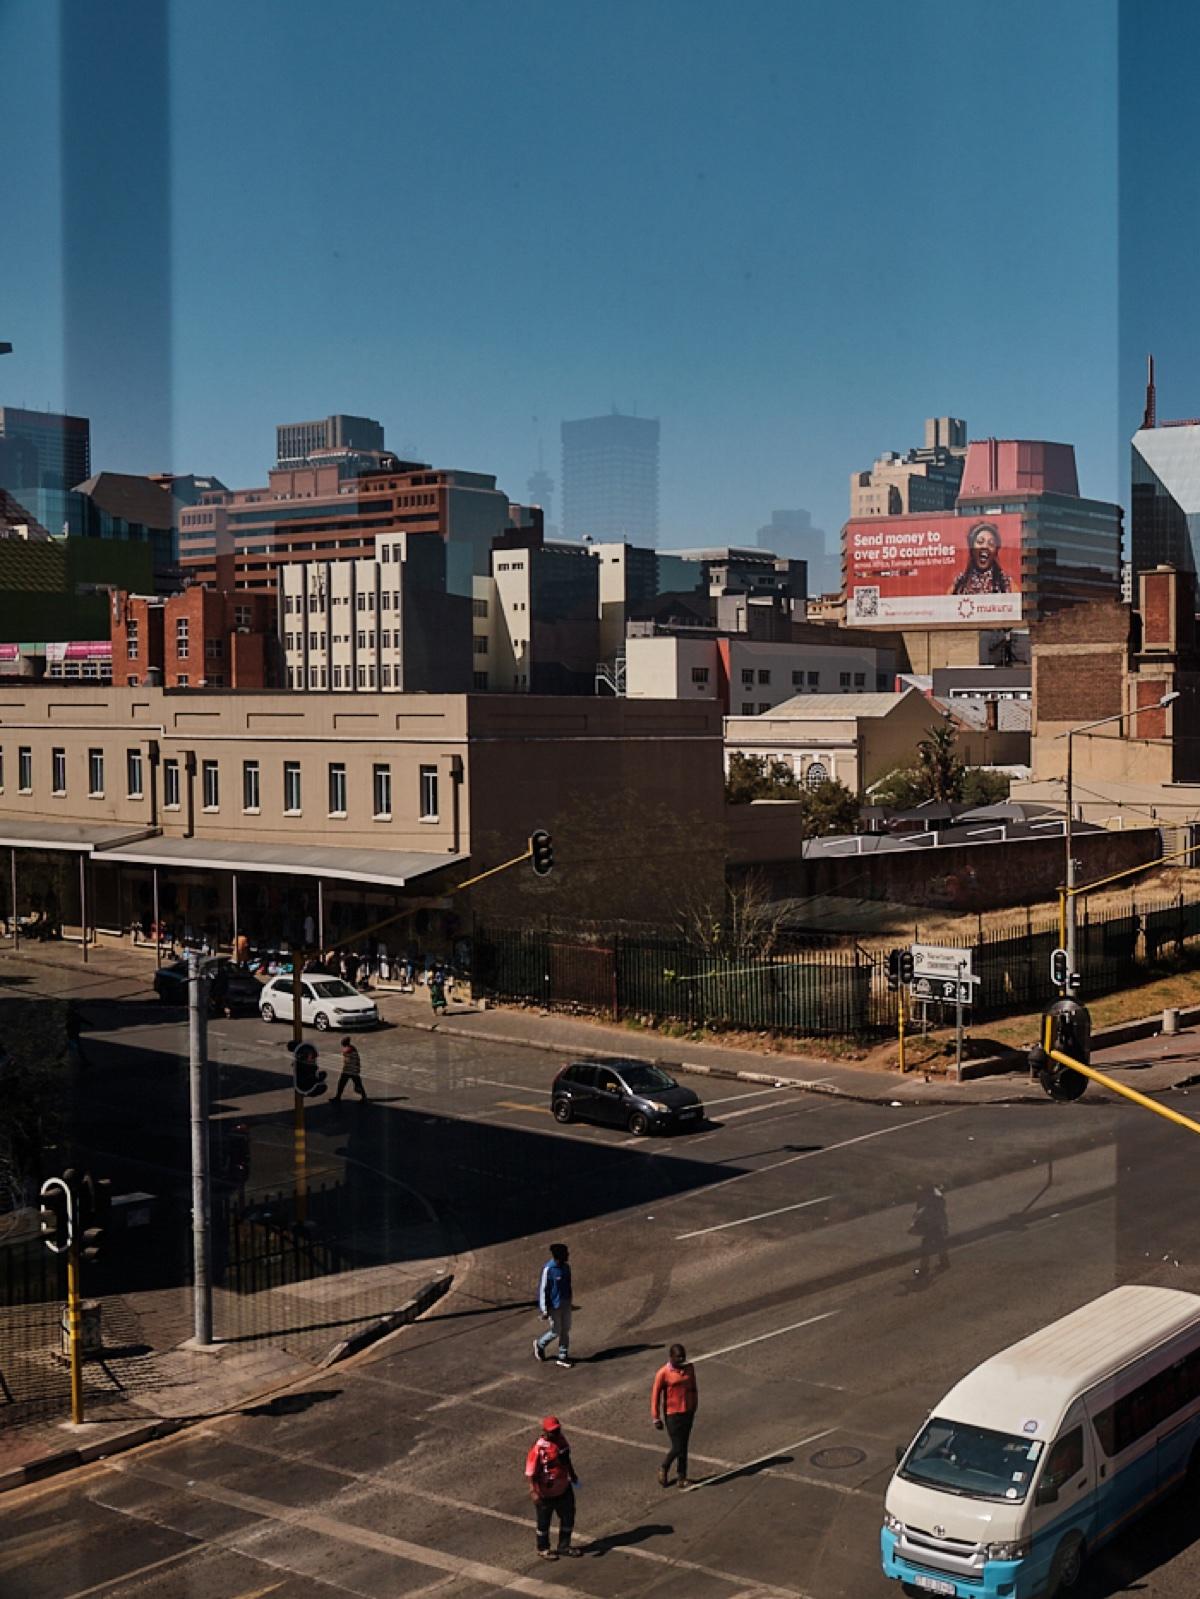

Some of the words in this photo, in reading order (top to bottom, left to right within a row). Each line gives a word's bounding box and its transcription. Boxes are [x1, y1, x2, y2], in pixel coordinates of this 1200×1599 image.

[853, 533, 883, 546] Send
[885, 532, 925, 545] money
[927, 531, 940, 543] to
[853, 549, 880, 560] over
[882, 546, 897, 559] 50
[899, 543, 956, 558] countries
[976, 604, 1014, 613] mukuru
